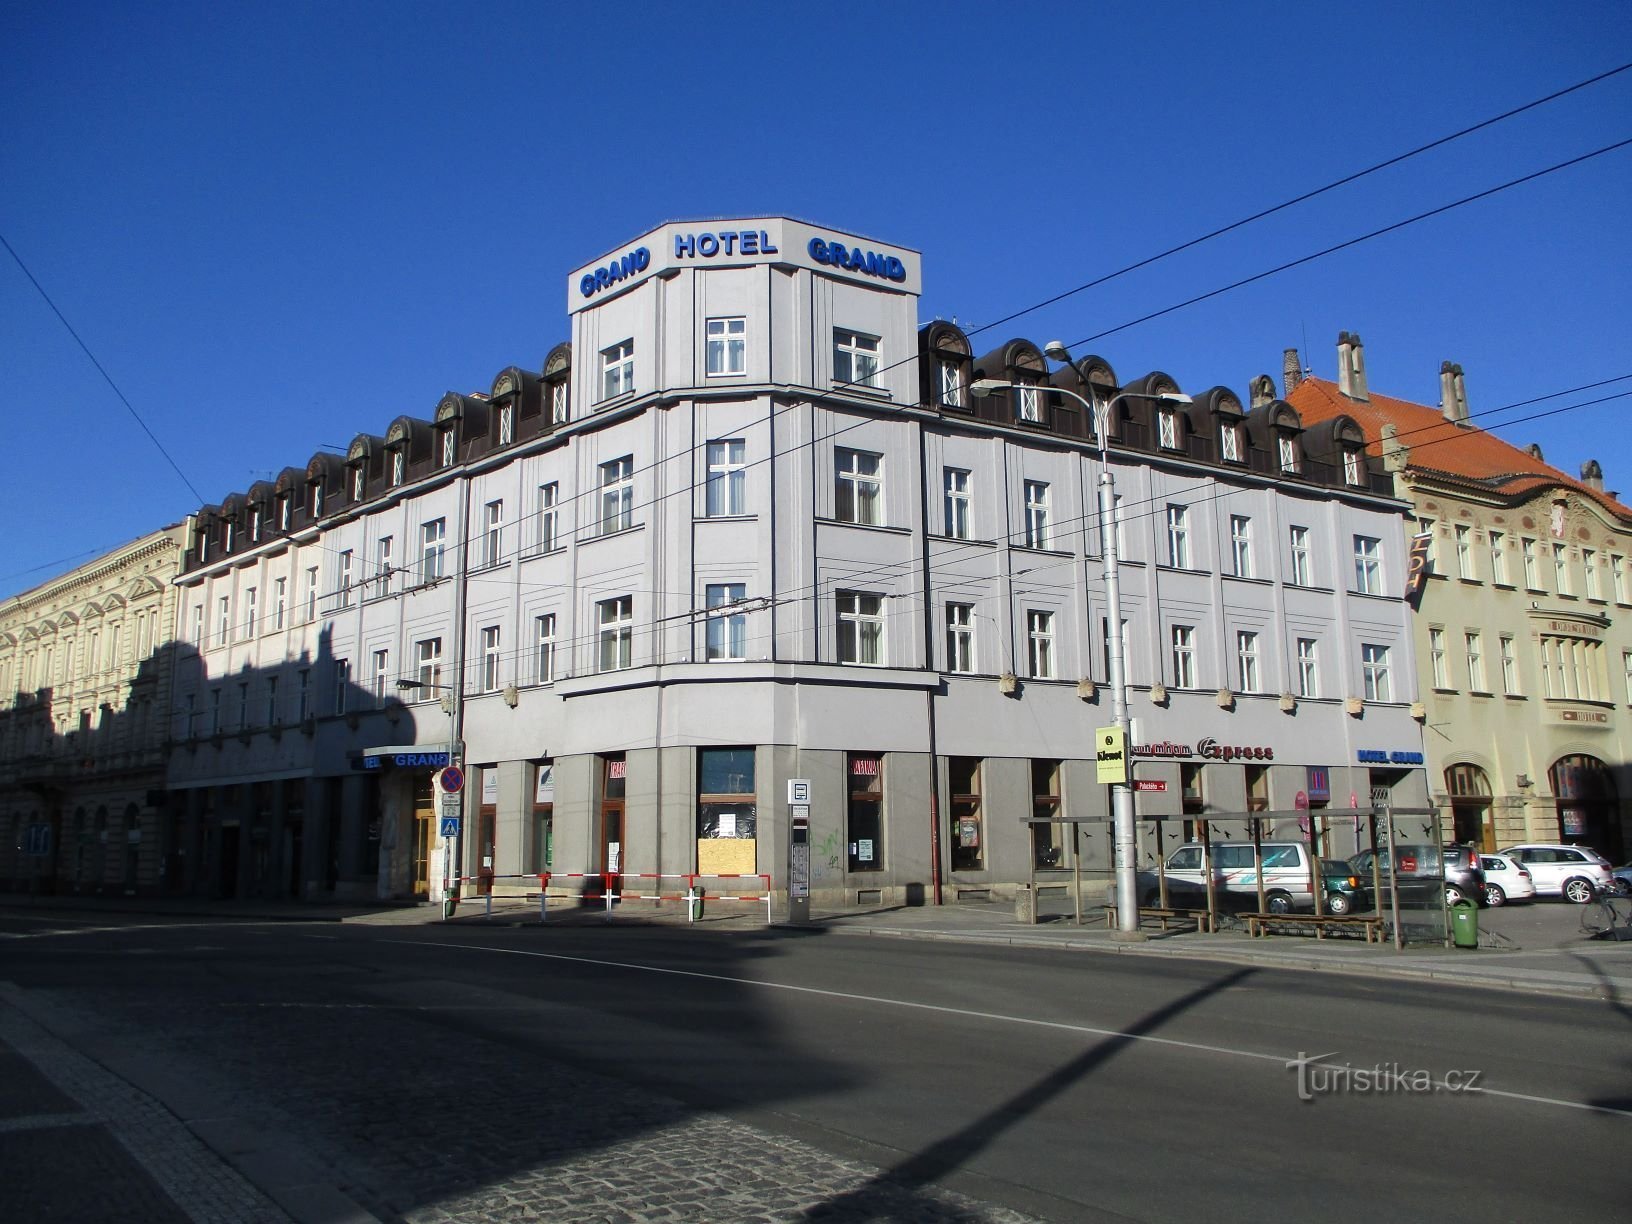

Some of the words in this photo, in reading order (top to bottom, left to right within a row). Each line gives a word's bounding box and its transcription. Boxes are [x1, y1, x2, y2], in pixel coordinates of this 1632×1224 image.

[674, 229, 778, 258] HOTEL
[579, 246, 651, 298] GRAND
[807, 237, 907, 282] GRAND
[396, 753, 449, 767] GRAND
[1197, 737, 1274, 762] Express
